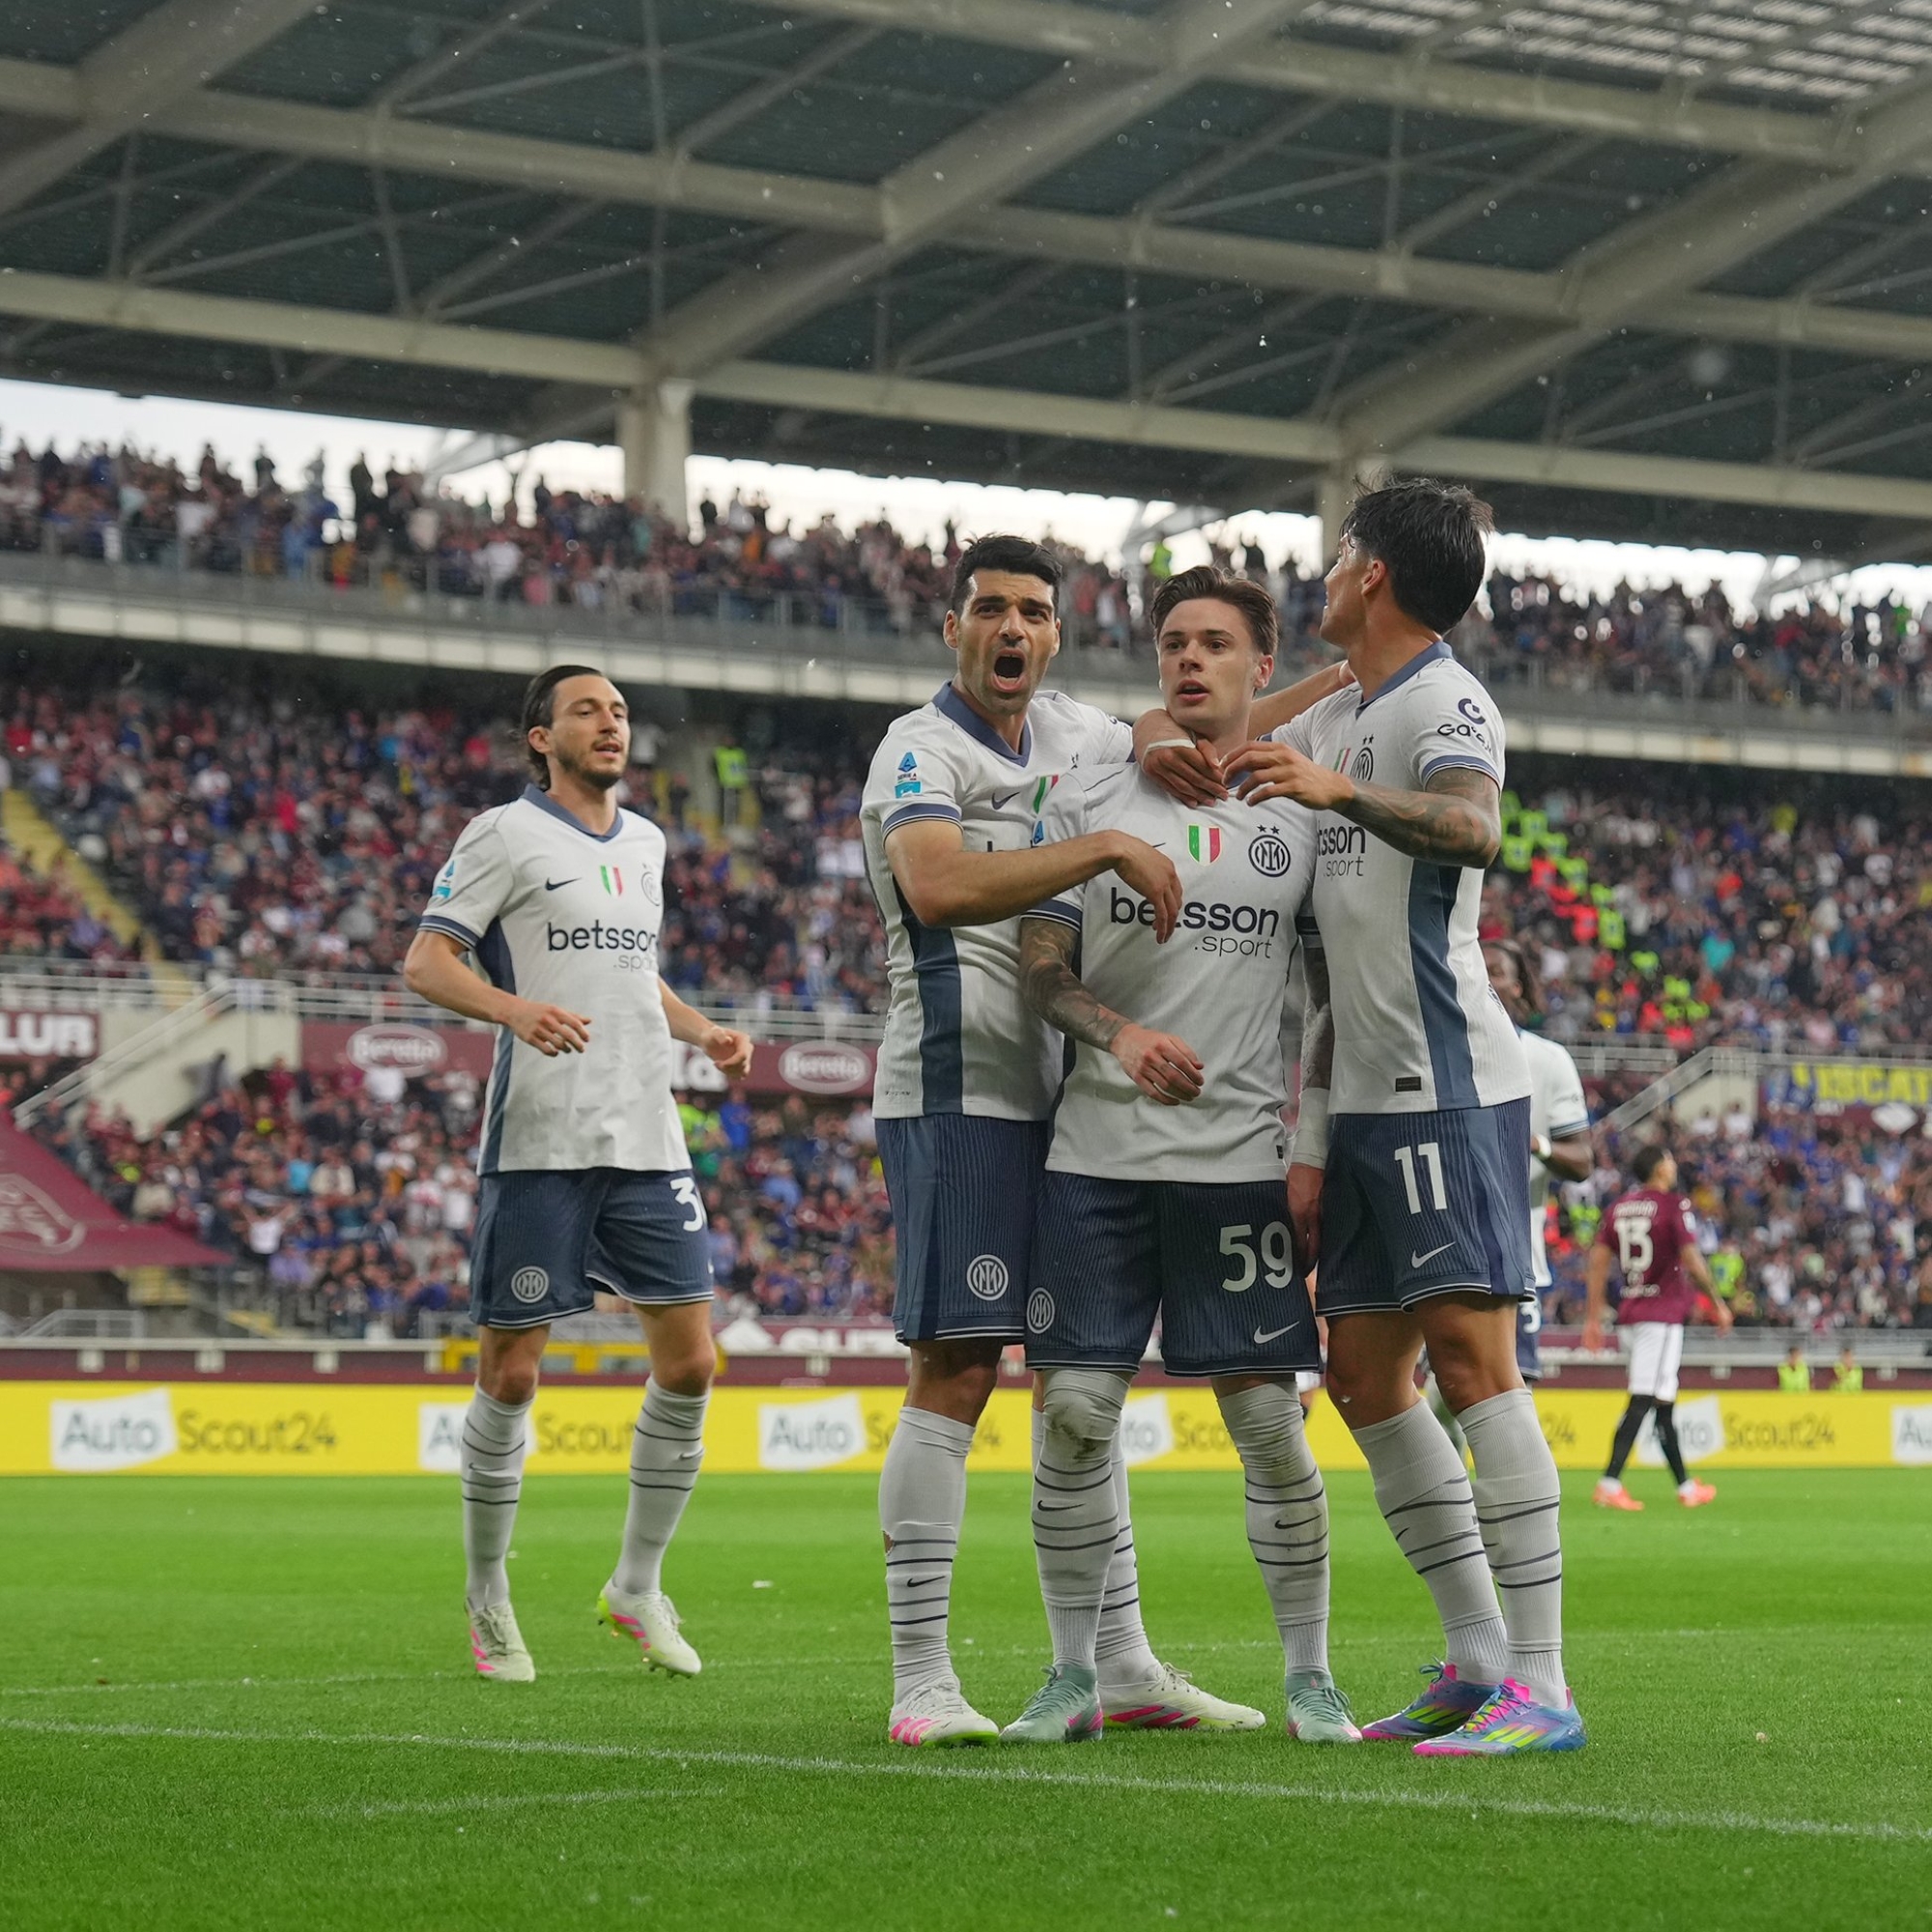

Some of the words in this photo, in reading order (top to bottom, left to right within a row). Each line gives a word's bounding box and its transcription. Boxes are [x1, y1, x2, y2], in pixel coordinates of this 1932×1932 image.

[1111, 887, 1280, 938] besson
[1194, 934, 1273, 959] .sport
[669, 1176, 708, 1232] 3
[1394, 1142, 1448, 1215] 11
[1219, 1220, 1293, 1293] 59
[1613, 1218, 1654, 1274] 13
